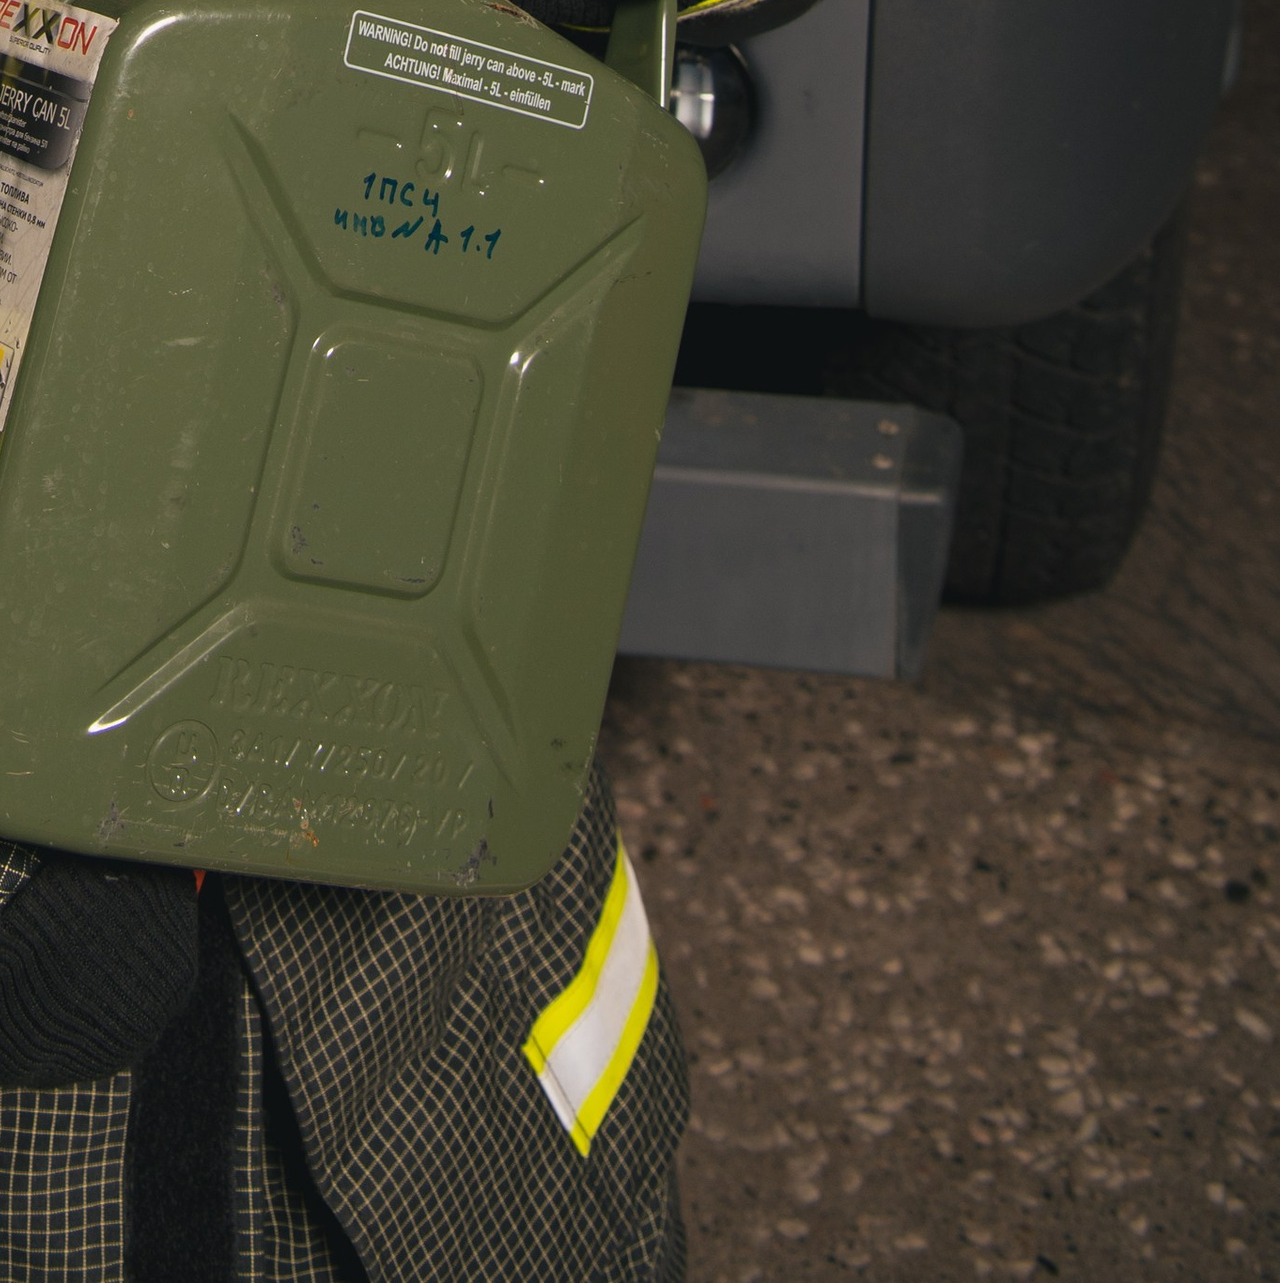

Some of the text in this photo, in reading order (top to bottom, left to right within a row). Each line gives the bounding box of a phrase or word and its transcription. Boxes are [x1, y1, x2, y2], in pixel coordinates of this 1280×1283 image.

[29, 41, 51, 55] QUALITY
[358, 20, 412, 48] WARNING!
[413, 35, 428, 52] Do
[430, 42, 448, 57] not
[449, 44, 462, 61] fill
[460, 48, 486, 71] jerry
[486, 58, 505, 74] can
[506, 62, 536, 83] above
[561, 79, 586, 97] mark
[384, 52, 441, 80] ACHTUNG!
[442, 67, 483, 92] Maximal
[509, 87, 551, 111] einfüllen
[32, 97, 58, 124] CAN
[57, 106, 70, 131] 5L
[0, 182, 29, 204] ТОПЛИВА
[6, 203, 27, 219] СТЕНКИ
[6, 271, 17, 284] ОТ
